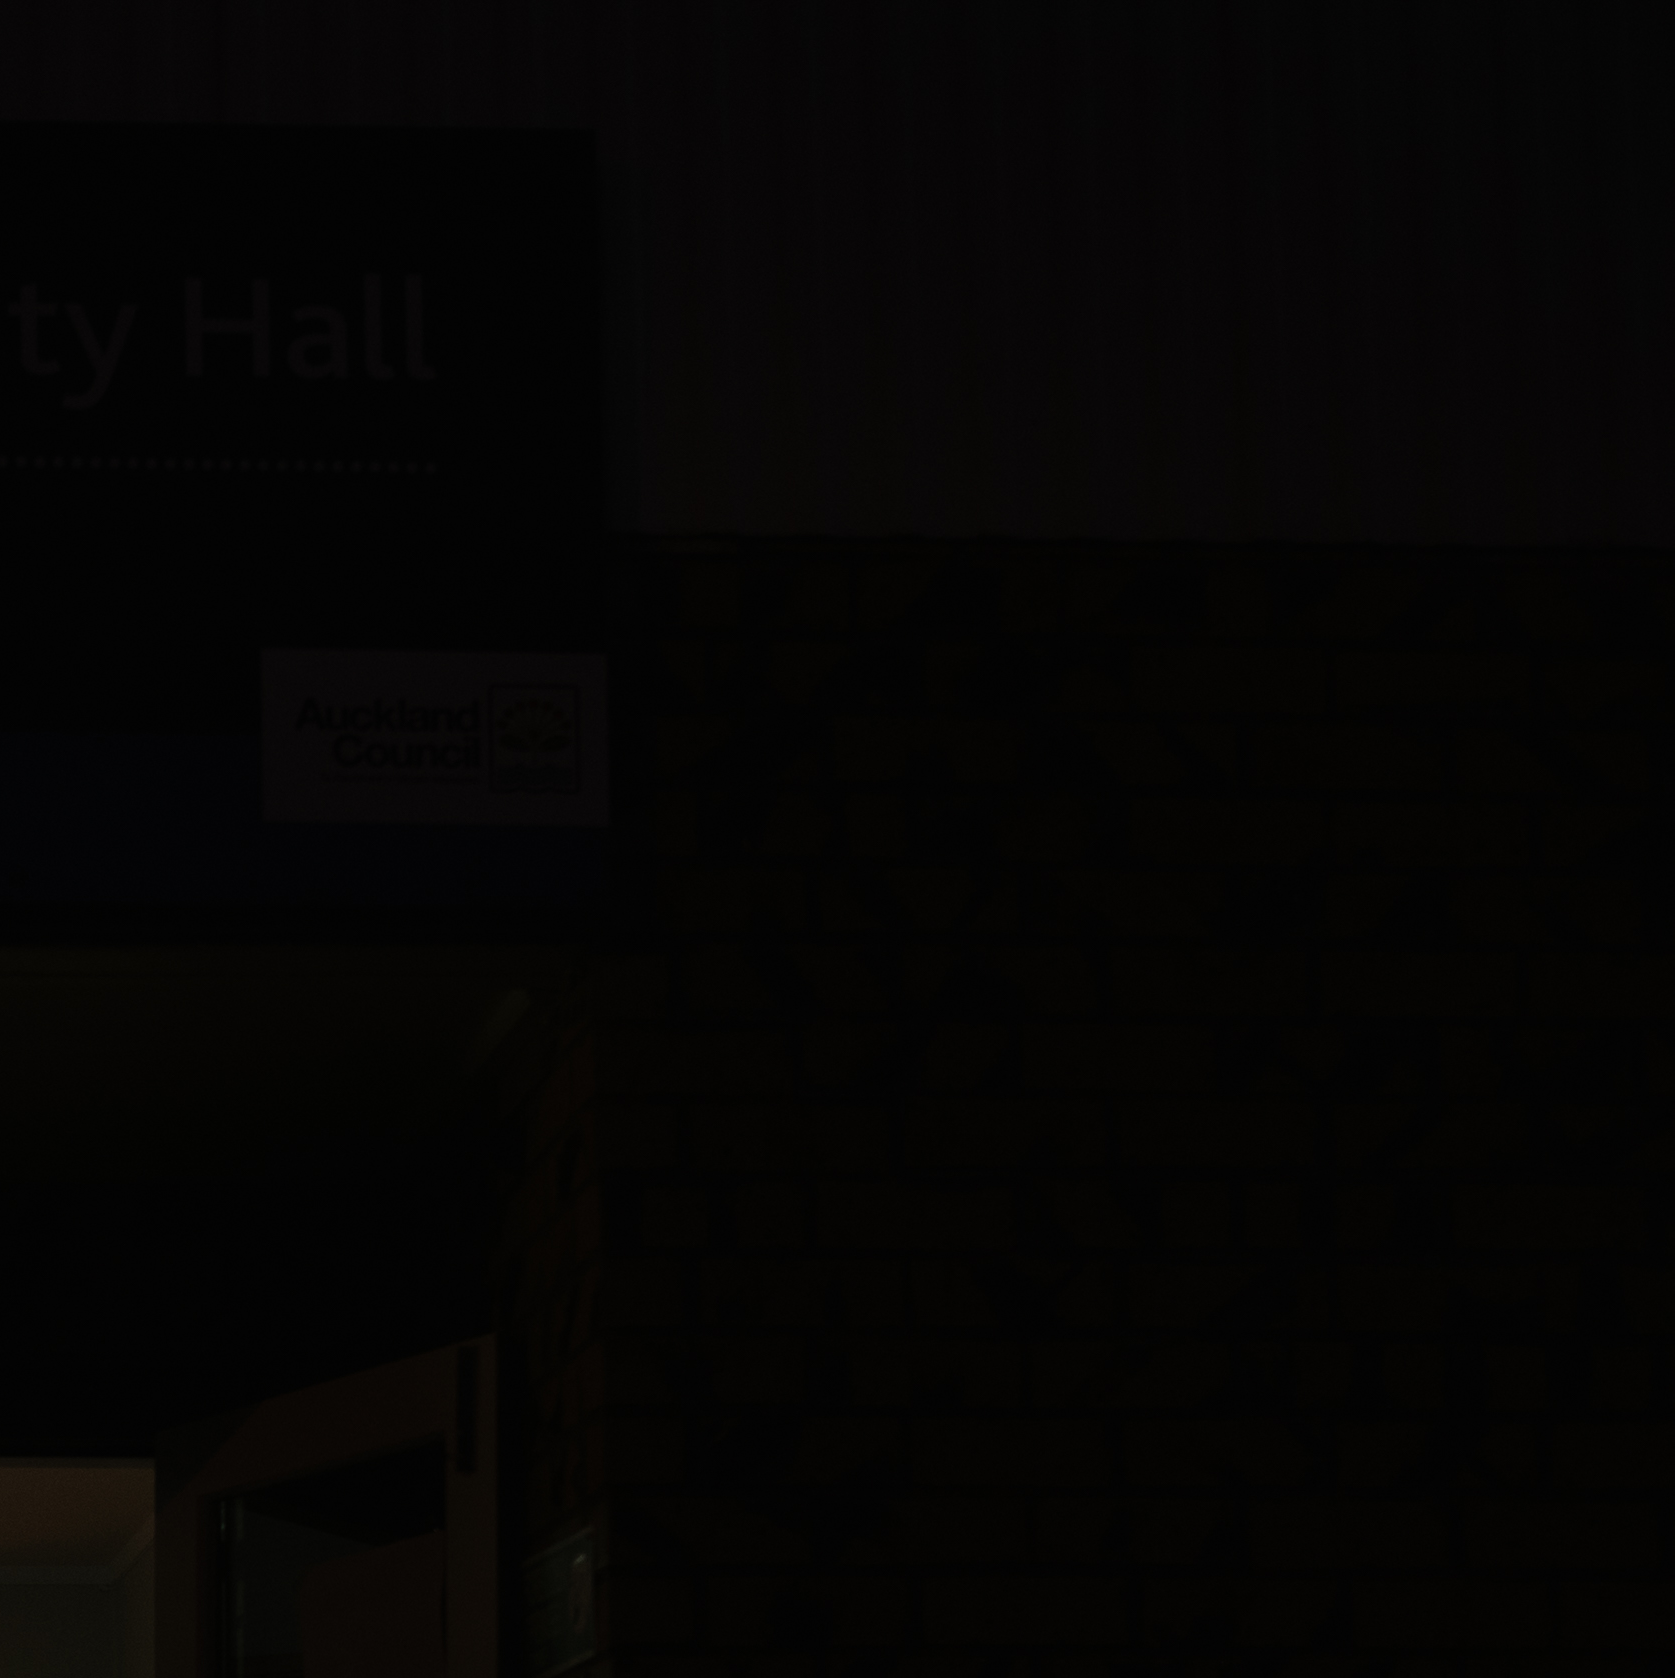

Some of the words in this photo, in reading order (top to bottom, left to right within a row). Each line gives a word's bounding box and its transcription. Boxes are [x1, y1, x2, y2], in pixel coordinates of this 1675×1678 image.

[186, 273, 436, 380] Hall
[295, 697, 480, 731] Auckland
[332, 733, 481, 769] Council
